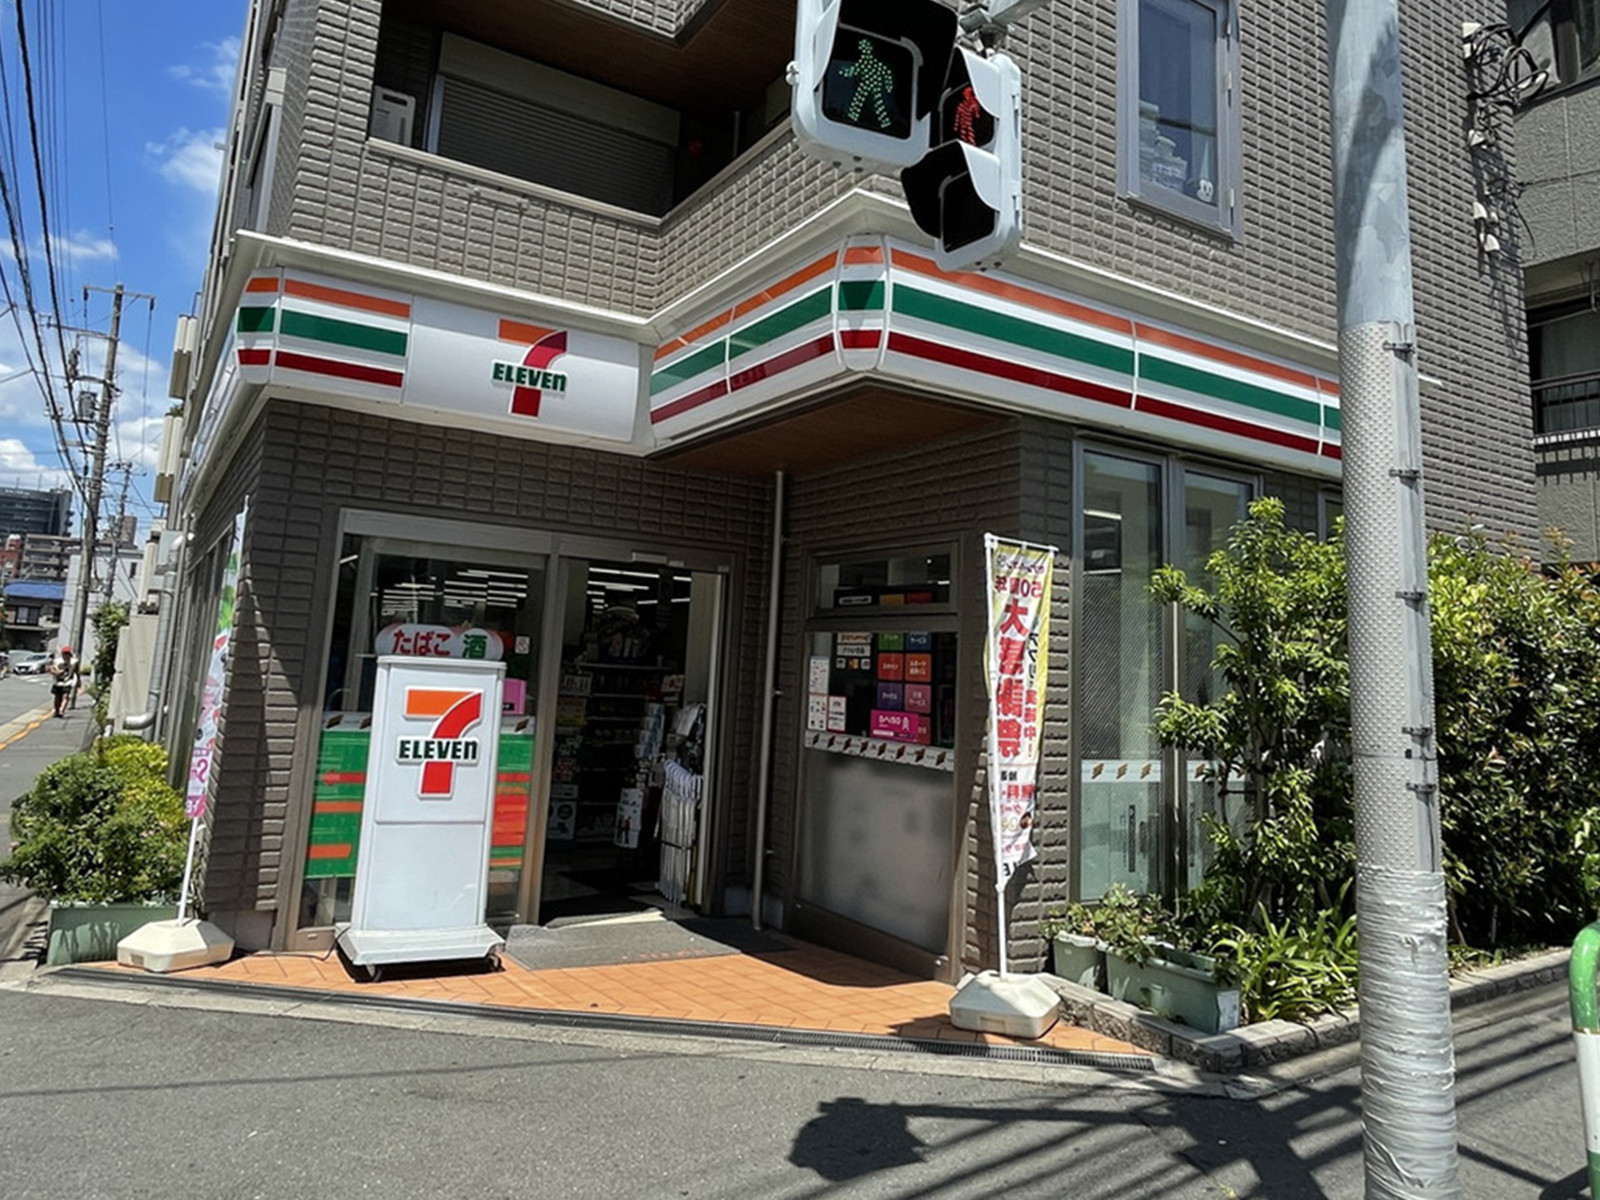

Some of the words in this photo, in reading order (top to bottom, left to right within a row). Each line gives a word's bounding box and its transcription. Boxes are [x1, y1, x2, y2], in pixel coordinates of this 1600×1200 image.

[392, 629, 451, 656] たばこ
[462, 634, 488, 659] 酒
